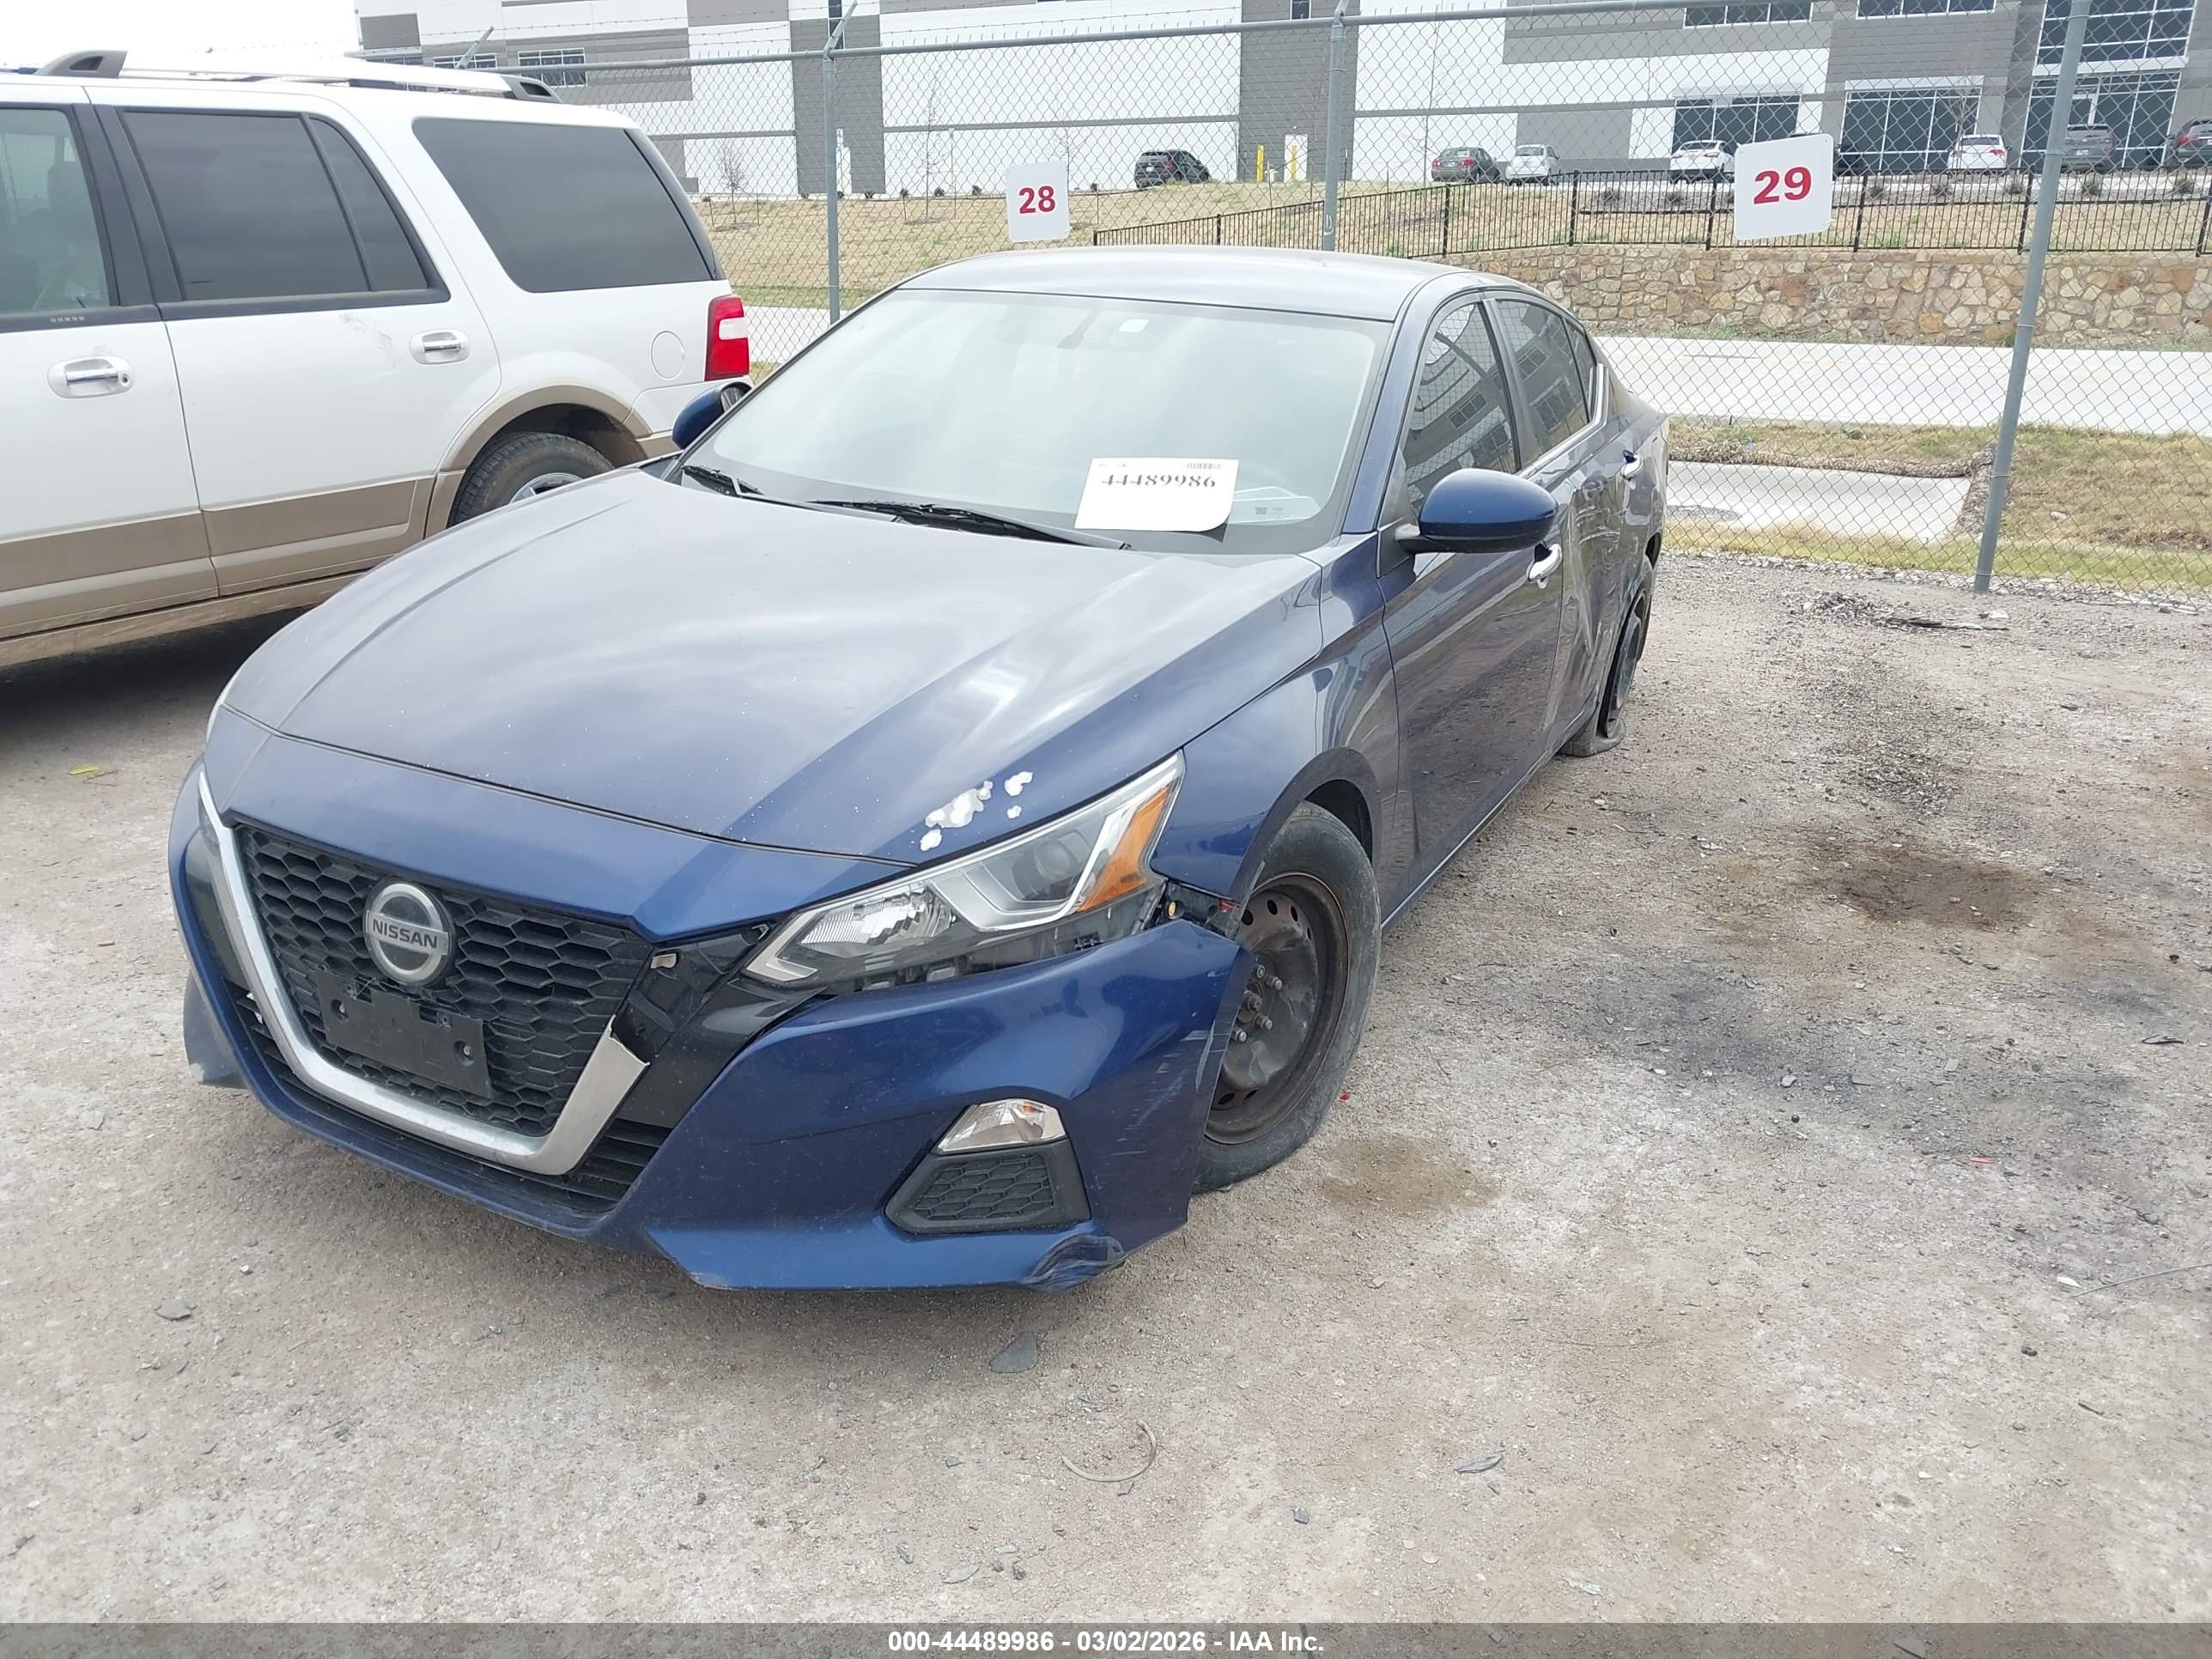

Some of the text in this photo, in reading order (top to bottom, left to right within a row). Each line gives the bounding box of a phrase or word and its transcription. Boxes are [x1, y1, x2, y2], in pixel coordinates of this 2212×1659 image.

[1018, 185, 1056, 214] 28
[1753, 167, 1812, 204] 29
[1101, 473, 1217, 488] 44489986
[373, 919, 438, 949] NISSAN
